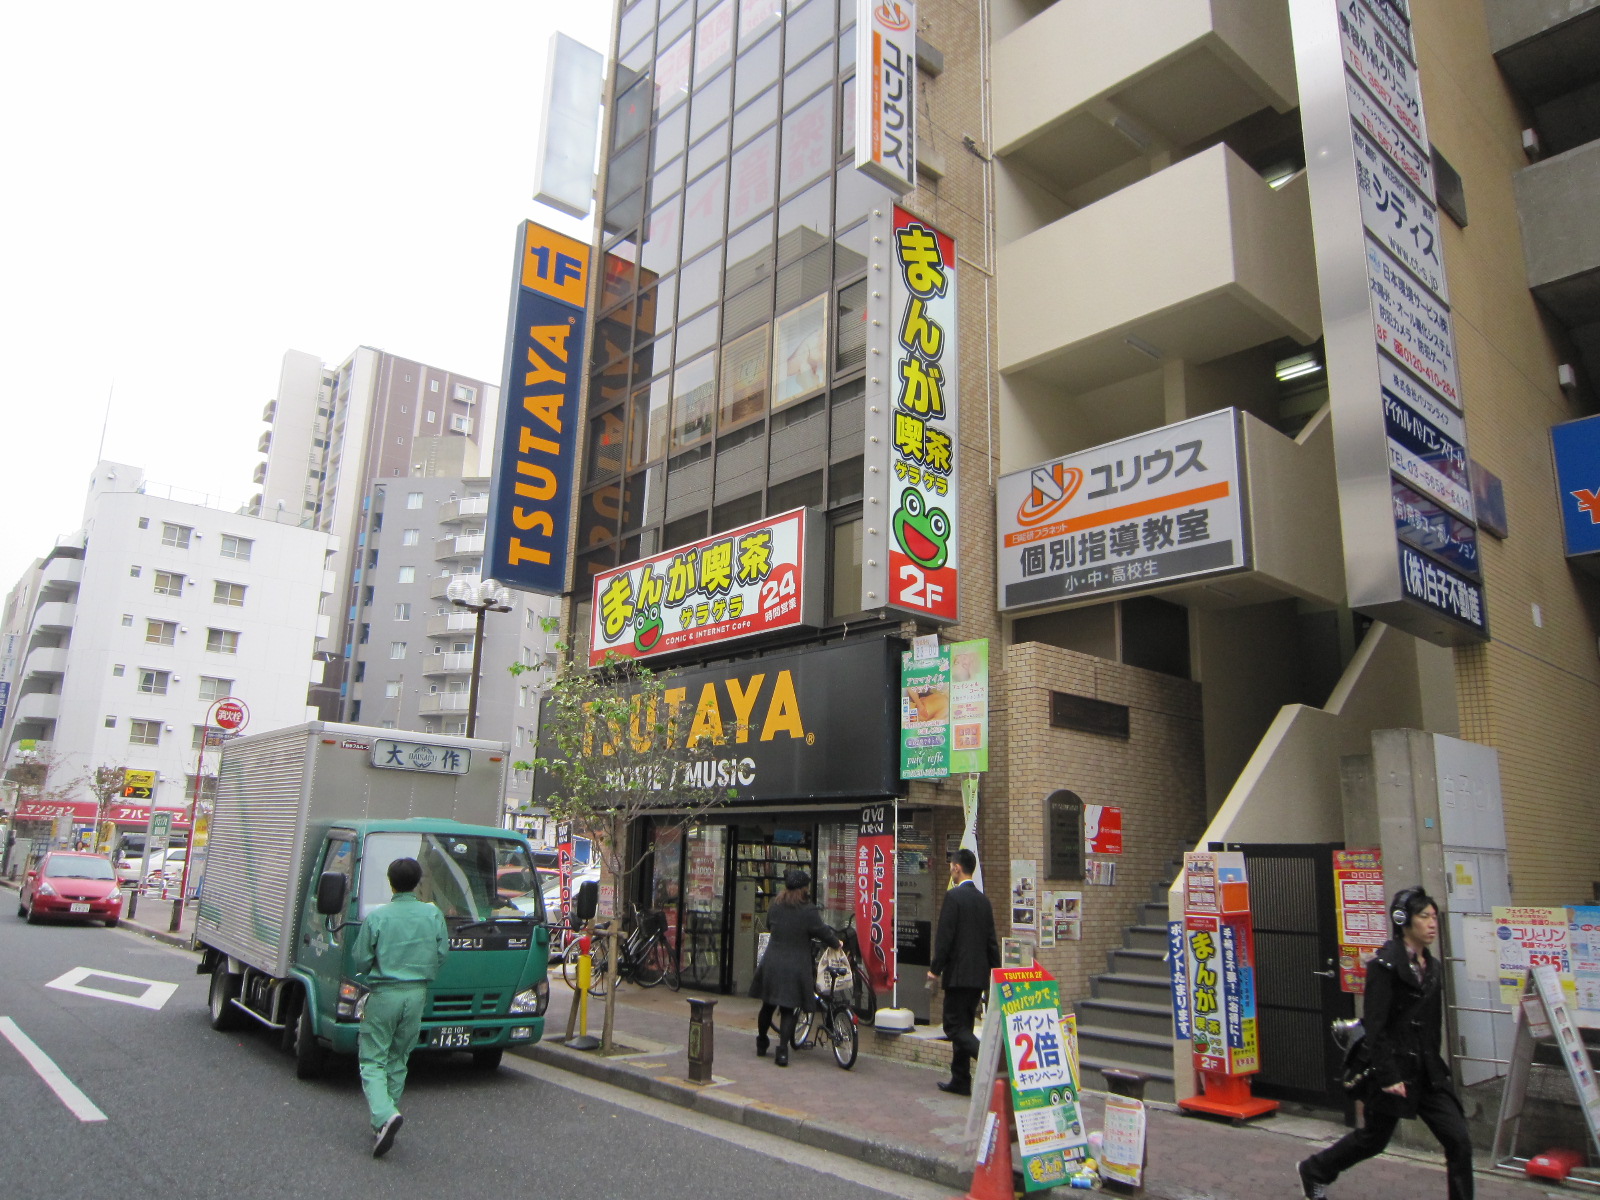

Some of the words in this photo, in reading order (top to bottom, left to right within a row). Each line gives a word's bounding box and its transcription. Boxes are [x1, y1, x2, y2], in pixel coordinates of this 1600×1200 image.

[1349, 1, 1365, 27] 4F
[1347, 46, 1367, 79] TEL
[883, 39, 905, 170] ユリウス
[1361, 112, 1377, 139] TEL
[1373, 173, 1439, 266] シティス
[530, 246, 582, 286] 1F
[897, 226, 946, 415] まんが
[508, 325, 571, 565] TSUTAYA
[896, 413, 951, 472] 喫茶
[1088, 440, 1208, 499] ユリウス
[1390, 448, 1406, 470] TEL
[895, 459, 949, 497] ゲラゲラ
[1020, 508, 1210, 578] 個別指導教室
[601, 530, 773, 639] まんが喫茶
[762, 571, 796, 609] 24
[900, 565, 944, 608] 2F
[1065, 561, 1158, 591] 小・中・高校生
[680, 594, 744, 629] ゲラゲラ
[764, 598, 797, 621] 時間営業
[665, 635, 687, 646] COMIC
[696, 624, 729, 639] INTERNET
[218, 709, 243, 724] 消火栓
[386, 744, 404, 767] 大
[441, 750, 461, 770] 作
[684, 757, 756, 788] MUSIC
[124, 787, 134, 797] P
[26, 804, 76, 815] マンション
[1512, 928, 1566, 942] コリとリン
[1004, 972, 1034, 980] TSUTAYA
[1035, 971, 1043, 979] 2F
[1171, 923, 1190, 1038] ポイントたまります。
[1190, 931, 1218, 1014] まんが
[1012, 1013, 1055, 1033] ポイント
[439, 1034, 470, 1048] 14-35
[1015, 1031, 1061, 1072] 2倍
[1019, 1069, 1064, 1085] キャンペーン
[1201, 1056, 1218, 1068] 2F
